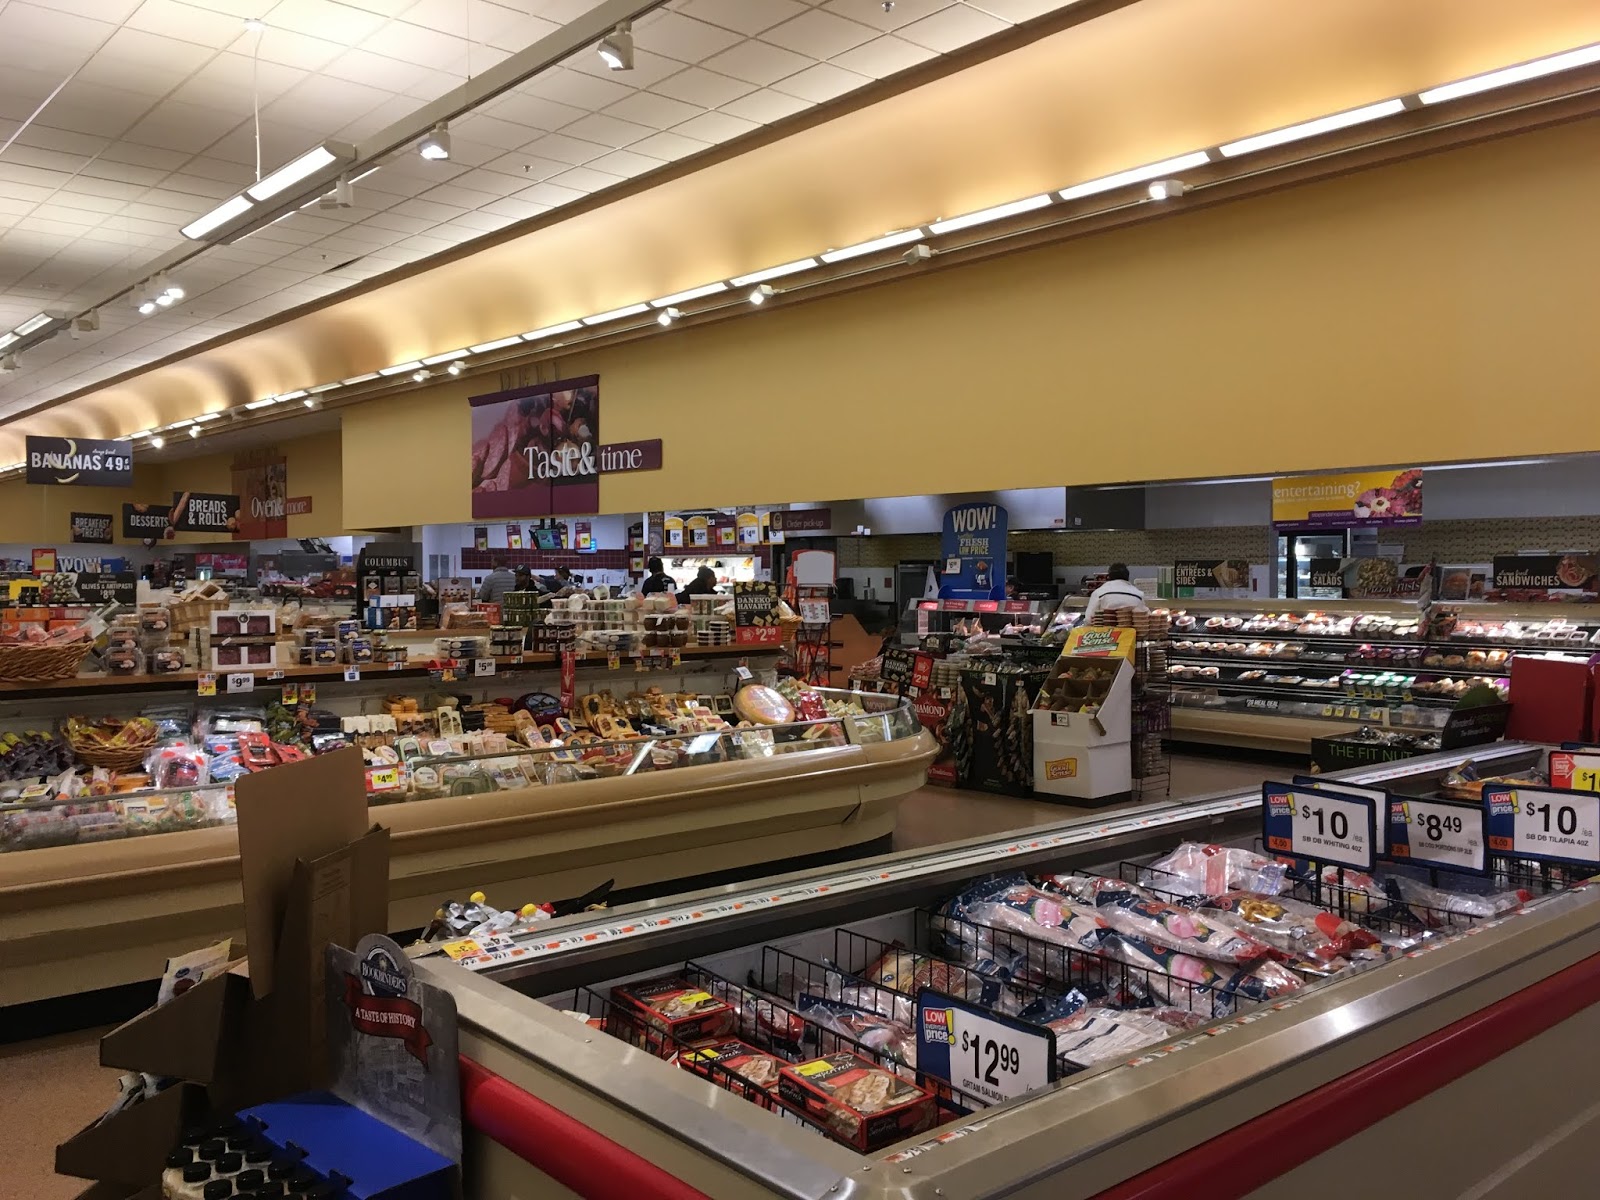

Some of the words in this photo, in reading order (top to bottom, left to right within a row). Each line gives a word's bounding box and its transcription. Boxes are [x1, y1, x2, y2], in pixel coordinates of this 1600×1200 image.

[31, 452, 102, 470] BANANAS
[601, 446, 643, 471] time
[1274, 481, 1361, 498] entertaining?
[189, 499, 227, 513] BREADS
[75, 517, 110, 529] BREAKFAST
[130, 514, 169, 528] DESSERTS
[188, 511, 196, 525] &
[198, 512, 228, 527] ROLLS
[786, 520, 802, 528] Order
[803, 519, 824, 529] pick-up
[952, 505, 997, 533] WOW!
[81, 527, 104, 539] TREATS
[960, 537, 989, 546] FRESH
[970, 545, 989, 555] PRICE
[364, 558, 408, 567] COLUMBUS
[1176, 568, 1206, 577] ENTREES
[1207, 568, 1213, 577] &
[1176, 576, 1196, 585] SIDES
[1312, 576, 1342, 586] SALADS
[1396, 580, 1420, 592] rusts
[1496, 575, 1560, 586] SANDWICHES
[1083, 628, 1113, 639] Good
[1082, 636, 1115, 646] Sense
[912, 703, 946, 717] DIAMOND
[1329, 744, 1355, 758] THE
[1359, 747, 1379, 760] FIT
[1050, 763, 1069, 772] Good
[1270, 796, 1288, 804] LOW
[1490, 794, 1510, 803] LOW
[1271, 807, 1291, 817] price
[1492, 805, 1513, 815] price
[1302, 805, 1349, 840] $10
[1526, 801, 1577, 836] $10
[1323, 839, 1350, 850] WHITING
[1549, 836, 1575, 845] TILAPIA
[1435, 843, 1456, 852] PORTIONS
[355, 1006, 360, 1018] A
[360, 1008, 380, 1023] TASTE
[380, 1011, 388, 1023] OF
[388, 1012, 416, 1029] HISTORY
[925, 1010, 946, 1023] LOW
[925, 1023, 947, 1031] EVERYDAY
[926, 1029, 948, 1041] price
[981, 1085, 1003, 1101] SALMON
